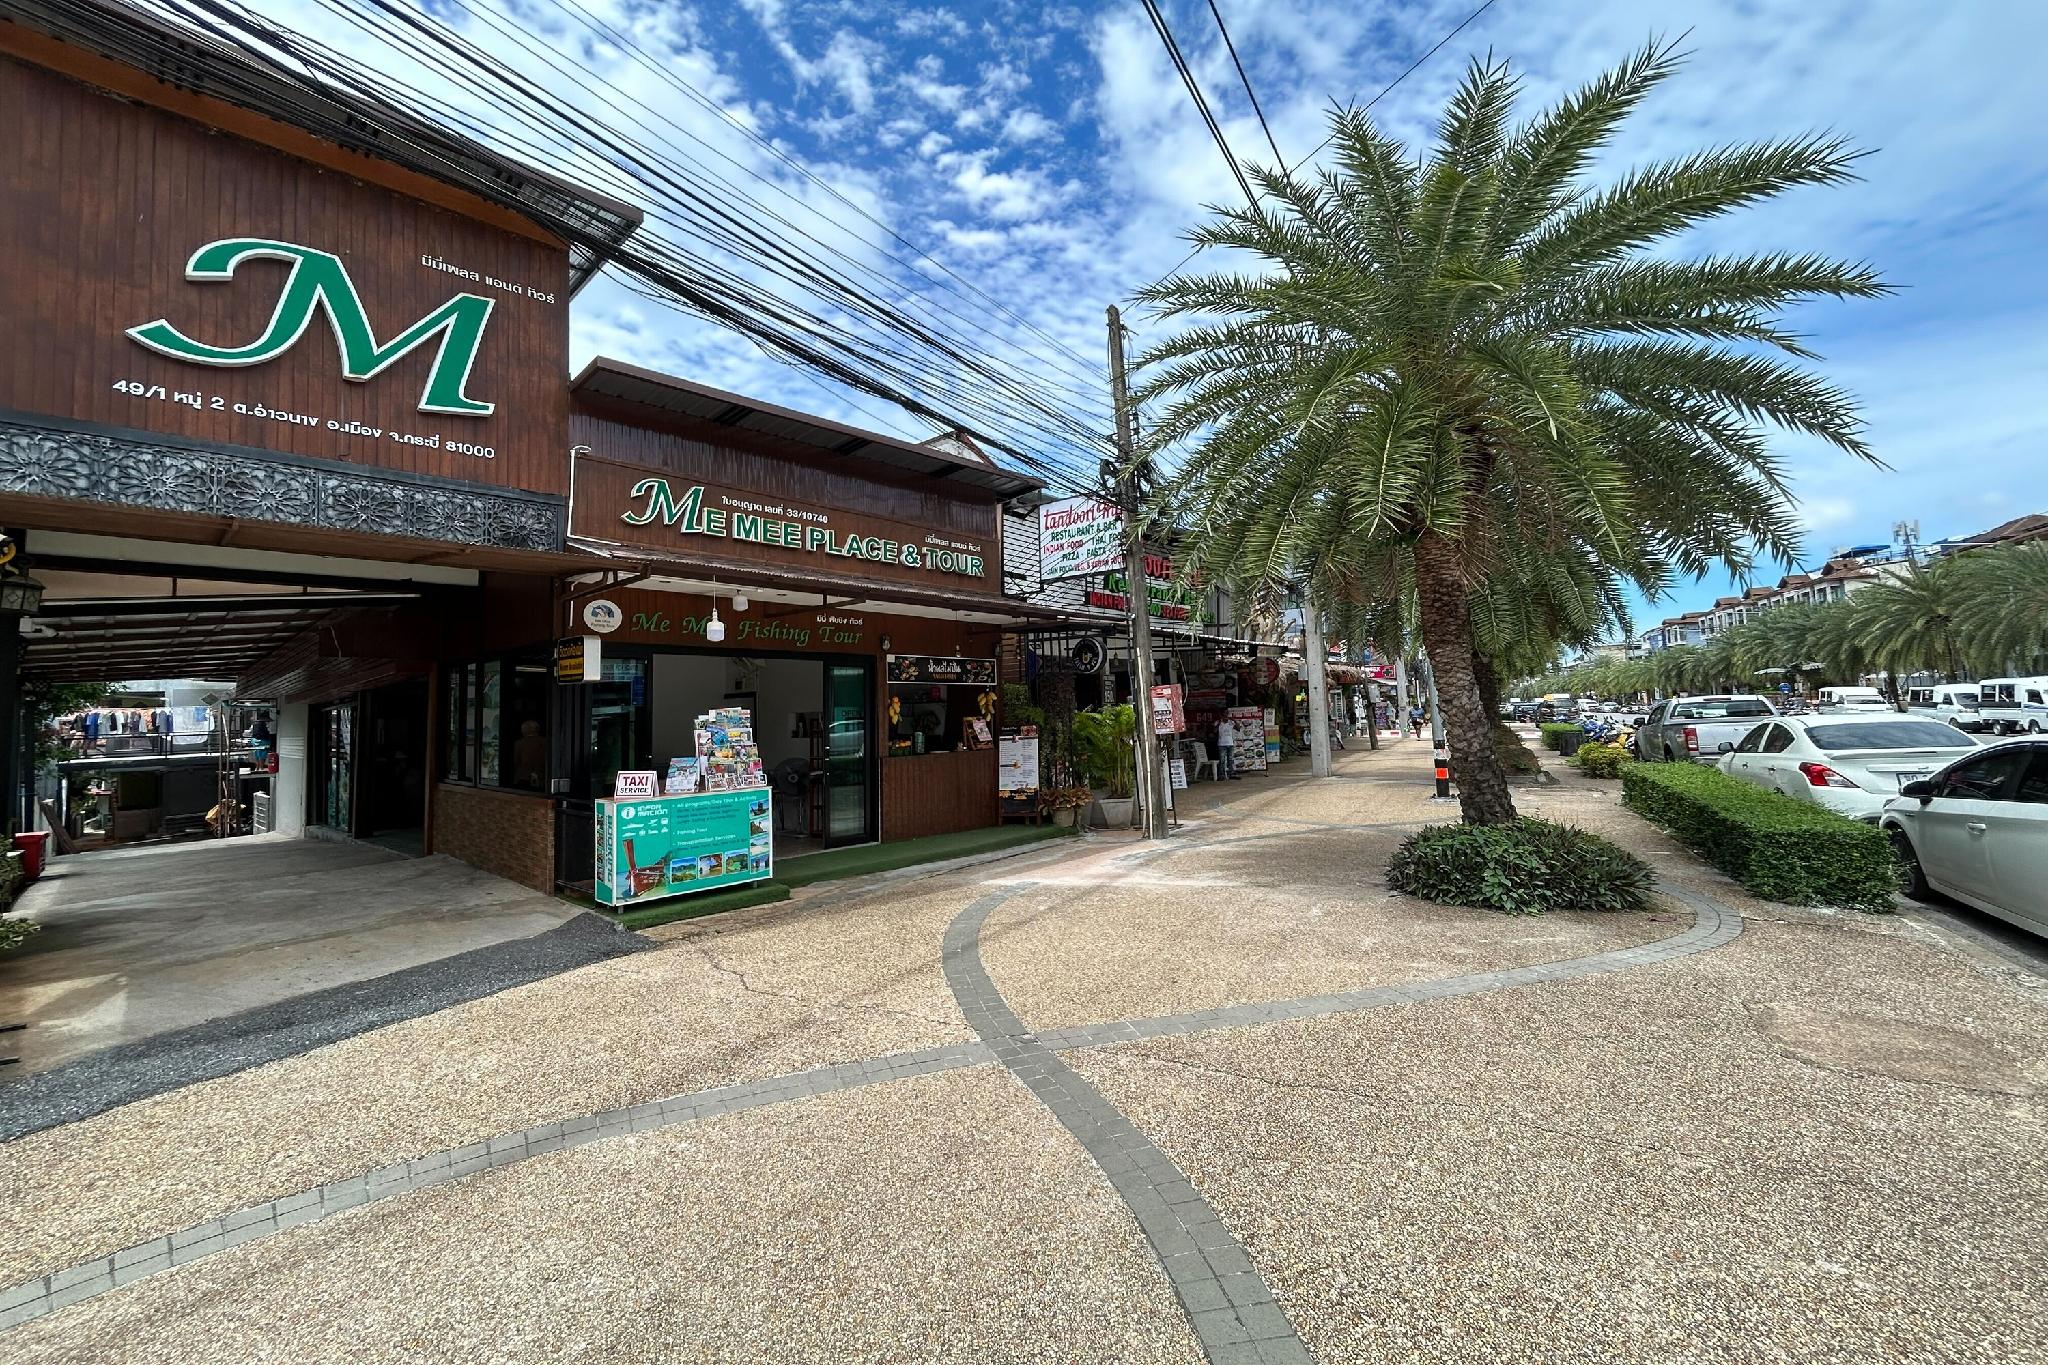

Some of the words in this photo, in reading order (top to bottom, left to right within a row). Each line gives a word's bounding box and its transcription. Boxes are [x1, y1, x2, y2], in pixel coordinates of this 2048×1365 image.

[112, 379, 167, 401] 49/1
[173, 391, 202, 410] หมู่
[210, 396, 225, 411] 2
[327, 419, 383, 438] อ.เมือง
[388, 431, 440, 449] จ.กระบี่
[445, 440, 496, 459] 81000
[786, 508, 829, 524] 33/10740
[732, 512, 802, 549] MEE
[805, 526, 899, 565] PLACE
[901, 543, 922, 567] &
[922, 546, 985, 578] TOUR
[1051, 524, 1095, 541] RESTAURANT
[631, 612, 671, 633] Me
[737, 620, 810, 647] Fishing
[819, 626, 863, 644] Tour
[623, 776, 649, 787] TAXI
